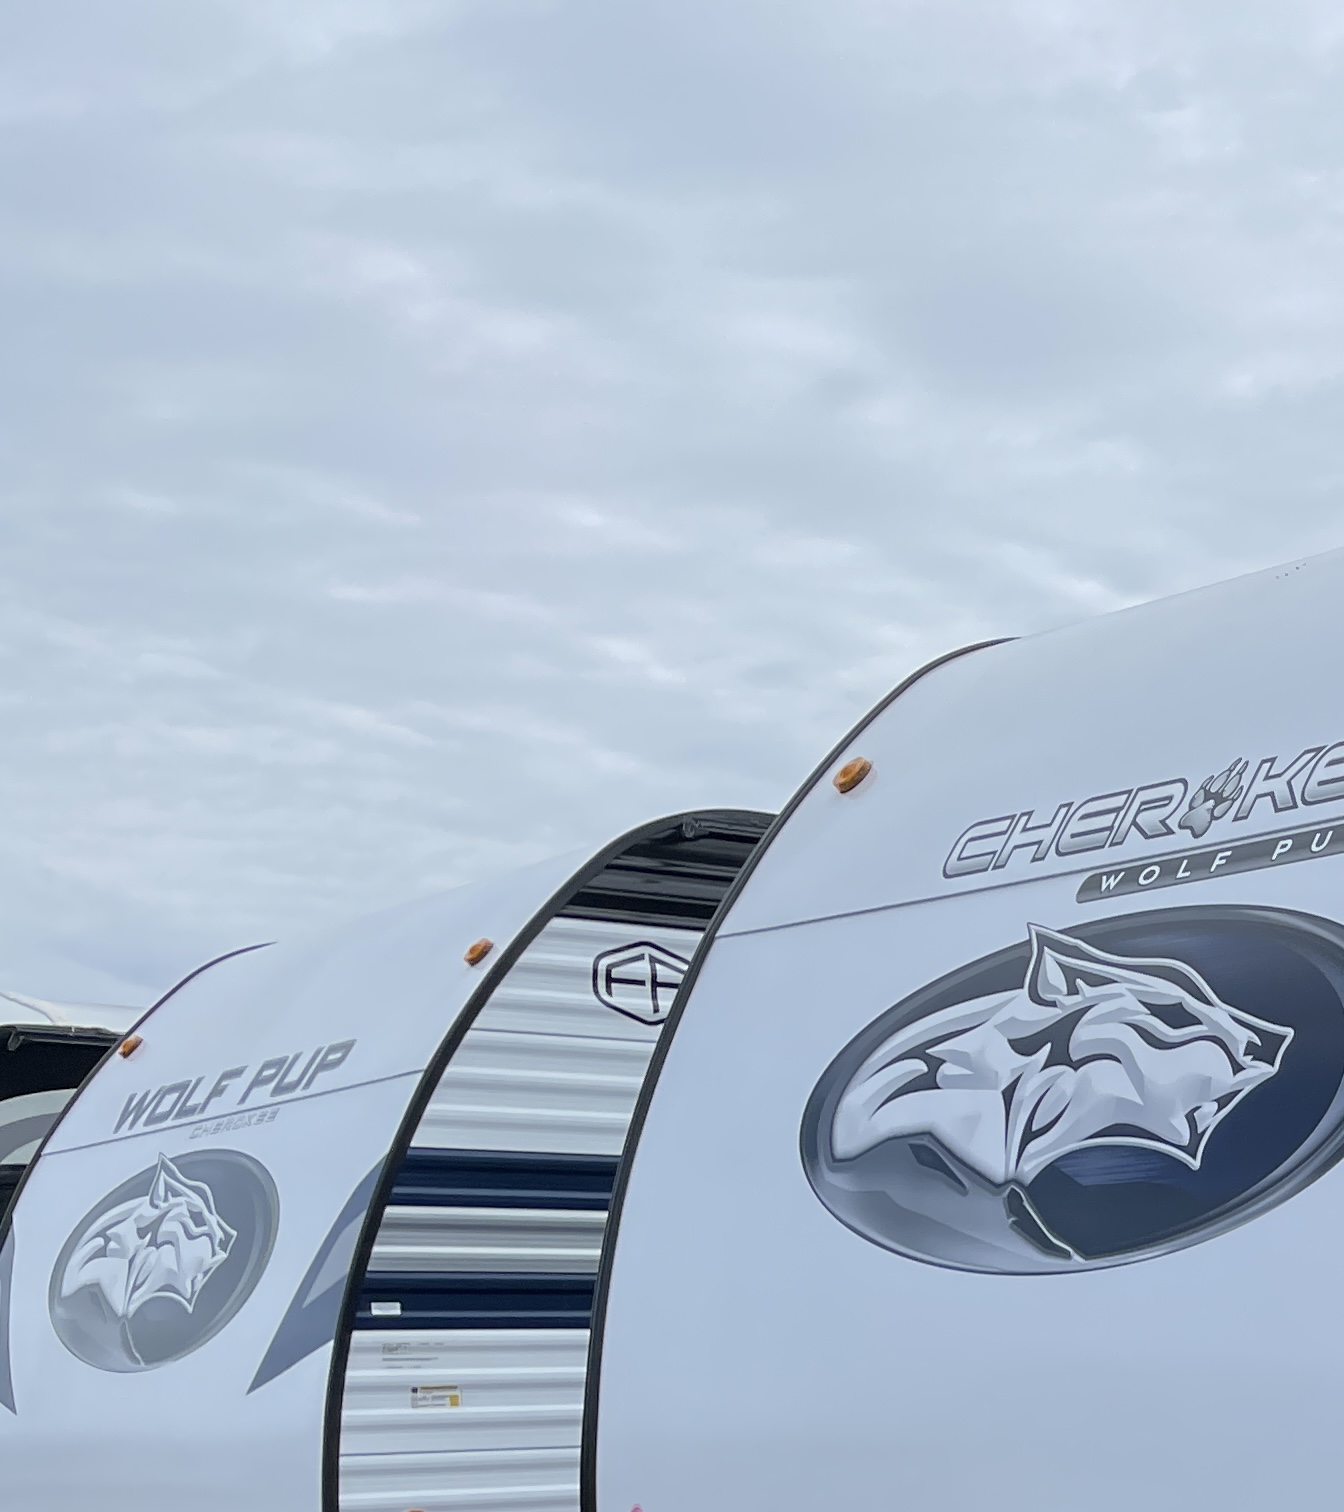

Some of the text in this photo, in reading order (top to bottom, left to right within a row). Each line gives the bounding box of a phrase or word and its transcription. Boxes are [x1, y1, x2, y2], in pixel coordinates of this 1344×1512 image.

[1100, 850, 1234, 894] WOLF
[112, 1037, 358, 1135] WOLF PUP
